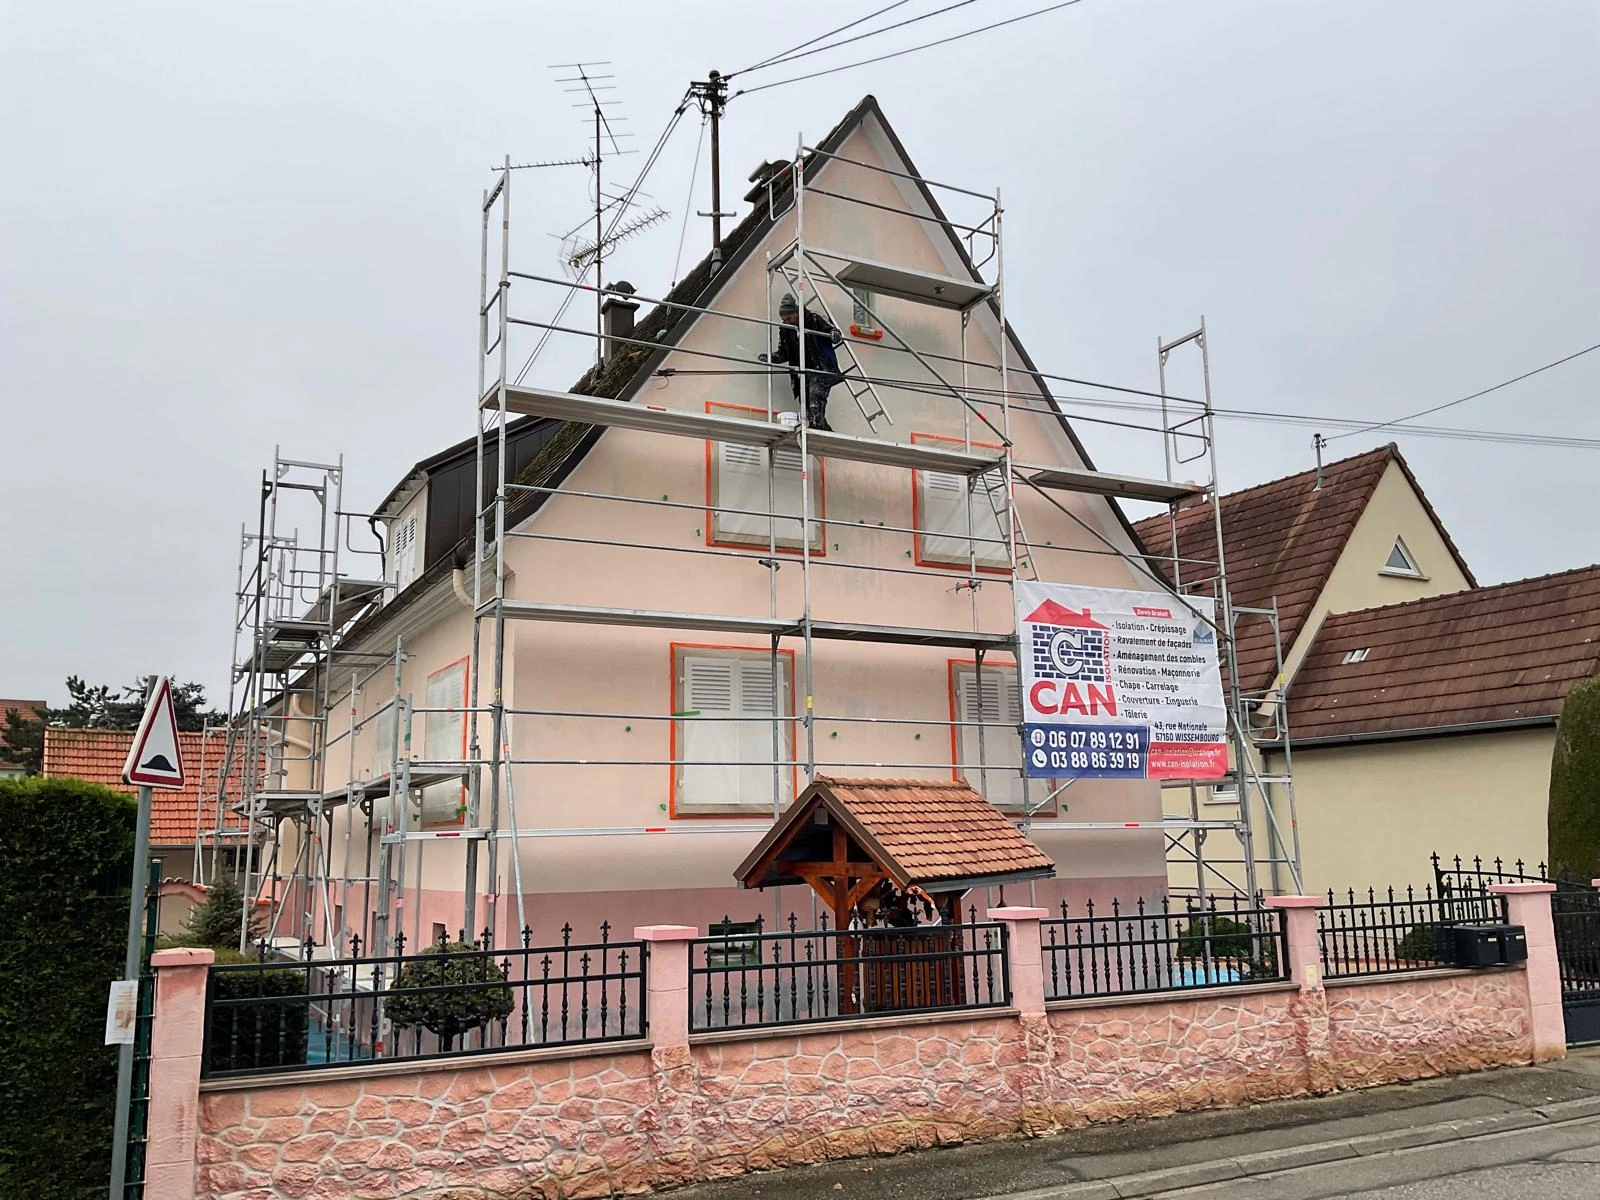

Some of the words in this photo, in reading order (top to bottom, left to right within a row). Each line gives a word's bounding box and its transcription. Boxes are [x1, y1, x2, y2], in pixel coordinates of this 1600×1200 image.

[1116, 621, 1146, 631] Isolation
[1150, 624, 1187, 635] Crépissage
[1117, 636, 1156, 646] Ravalement
[1157, 638, 1166, 647] de
[1167, 639, 1192, 650] façades
[1117, 650, 1165, 662] Aménagement
[1166, 653, 1178, 663] des
[1179, 654, 1206, 664] combles
[1118, 665, 1157, 676] Rénovation
[1161, 668, 1201, 680] Maçonnerie
[1119, 680, 1141, 690] Chape
[1145, 681, 1179, 693] Carrelage
[1029, 680, 1118, 717] CAN
[1121, 695, 1161, 705] Couverture
[1164, 696, 1199, 707] Zinguerie
[1124, 708, 1148, 719] Tôlerie
[1154, 721, 1165, 731] 43,
[1165, 723, 1177, 731] rue
[1178, 721, 1208, 731] Nationale
[1048, 730, 1067, 748] 06
[1070, 731, 1086, 749] 07
[1089, 732, 1107, 749] 89
[1108, 732, 1123, 750] 12
[1126, 733, 1140, 750] 91
[1155, 732, 1174, 742] 67160
[1175, 732, 1220, 742] WISSEMBOURG
[1050, 751, 1068, 769] 03
[1071, 751, 1089, 769] 88
[1091, 751, 1108, 769] 86
[1109, 752, 1125, 769] 39
[1126, 752, 1140, 769] 19
[1151, 759, 1216, 768] www.can-isolation.fr
